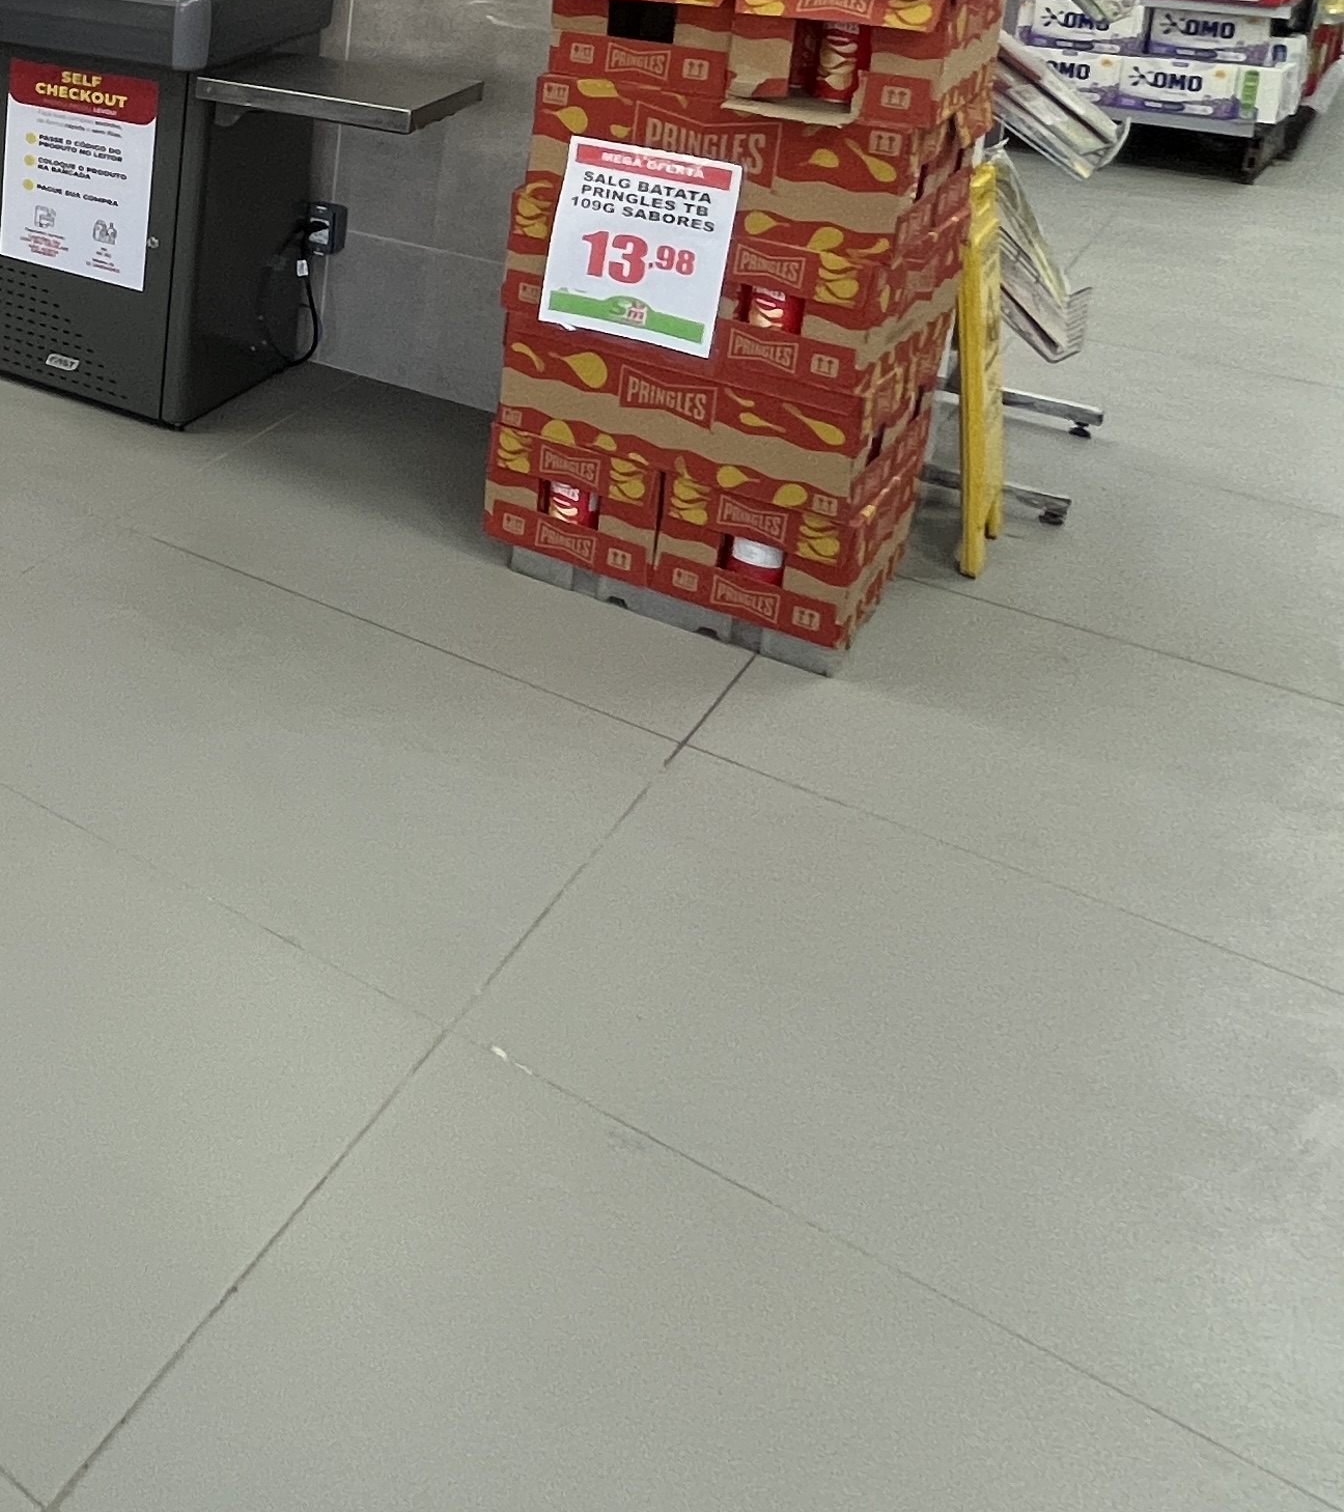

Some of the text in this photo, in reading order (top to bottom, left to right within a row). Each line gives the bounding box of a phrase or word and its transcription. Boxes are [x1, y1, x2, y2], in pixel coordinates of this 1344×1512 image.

[1186, 18, 1236, 39] OMO
[612, 47, 667, 76] PRINGLES
[34, 82, 128, 108] CHECKOUT
[61, 71, 102, 87] SELF
[1153, 71, 1203, 93] OMO
[645, 116, 766, 175] PRINGLES
[601, 151, 705, 179] MEGA OFERTA
[581, 184, 709, 217] PRINGLES TB
[583, 171, 712, 204] SALG BATATA
[570, 195, 715, 232] 109G SABORES
[582, 230, 696, 284] 13.98
[740, 250, 800, 282] PRINGLES
[734, 334, 792, 367] PRINGLES
[626, 375, 707, 421] PRINGLES
[544, 450, 596, 482] PRINGLES
[721, 502, 784, 537] PRINGLES
[539, 525, 592, 558] PRINGLES
[715, 581, 777, 616] PRINGLES
